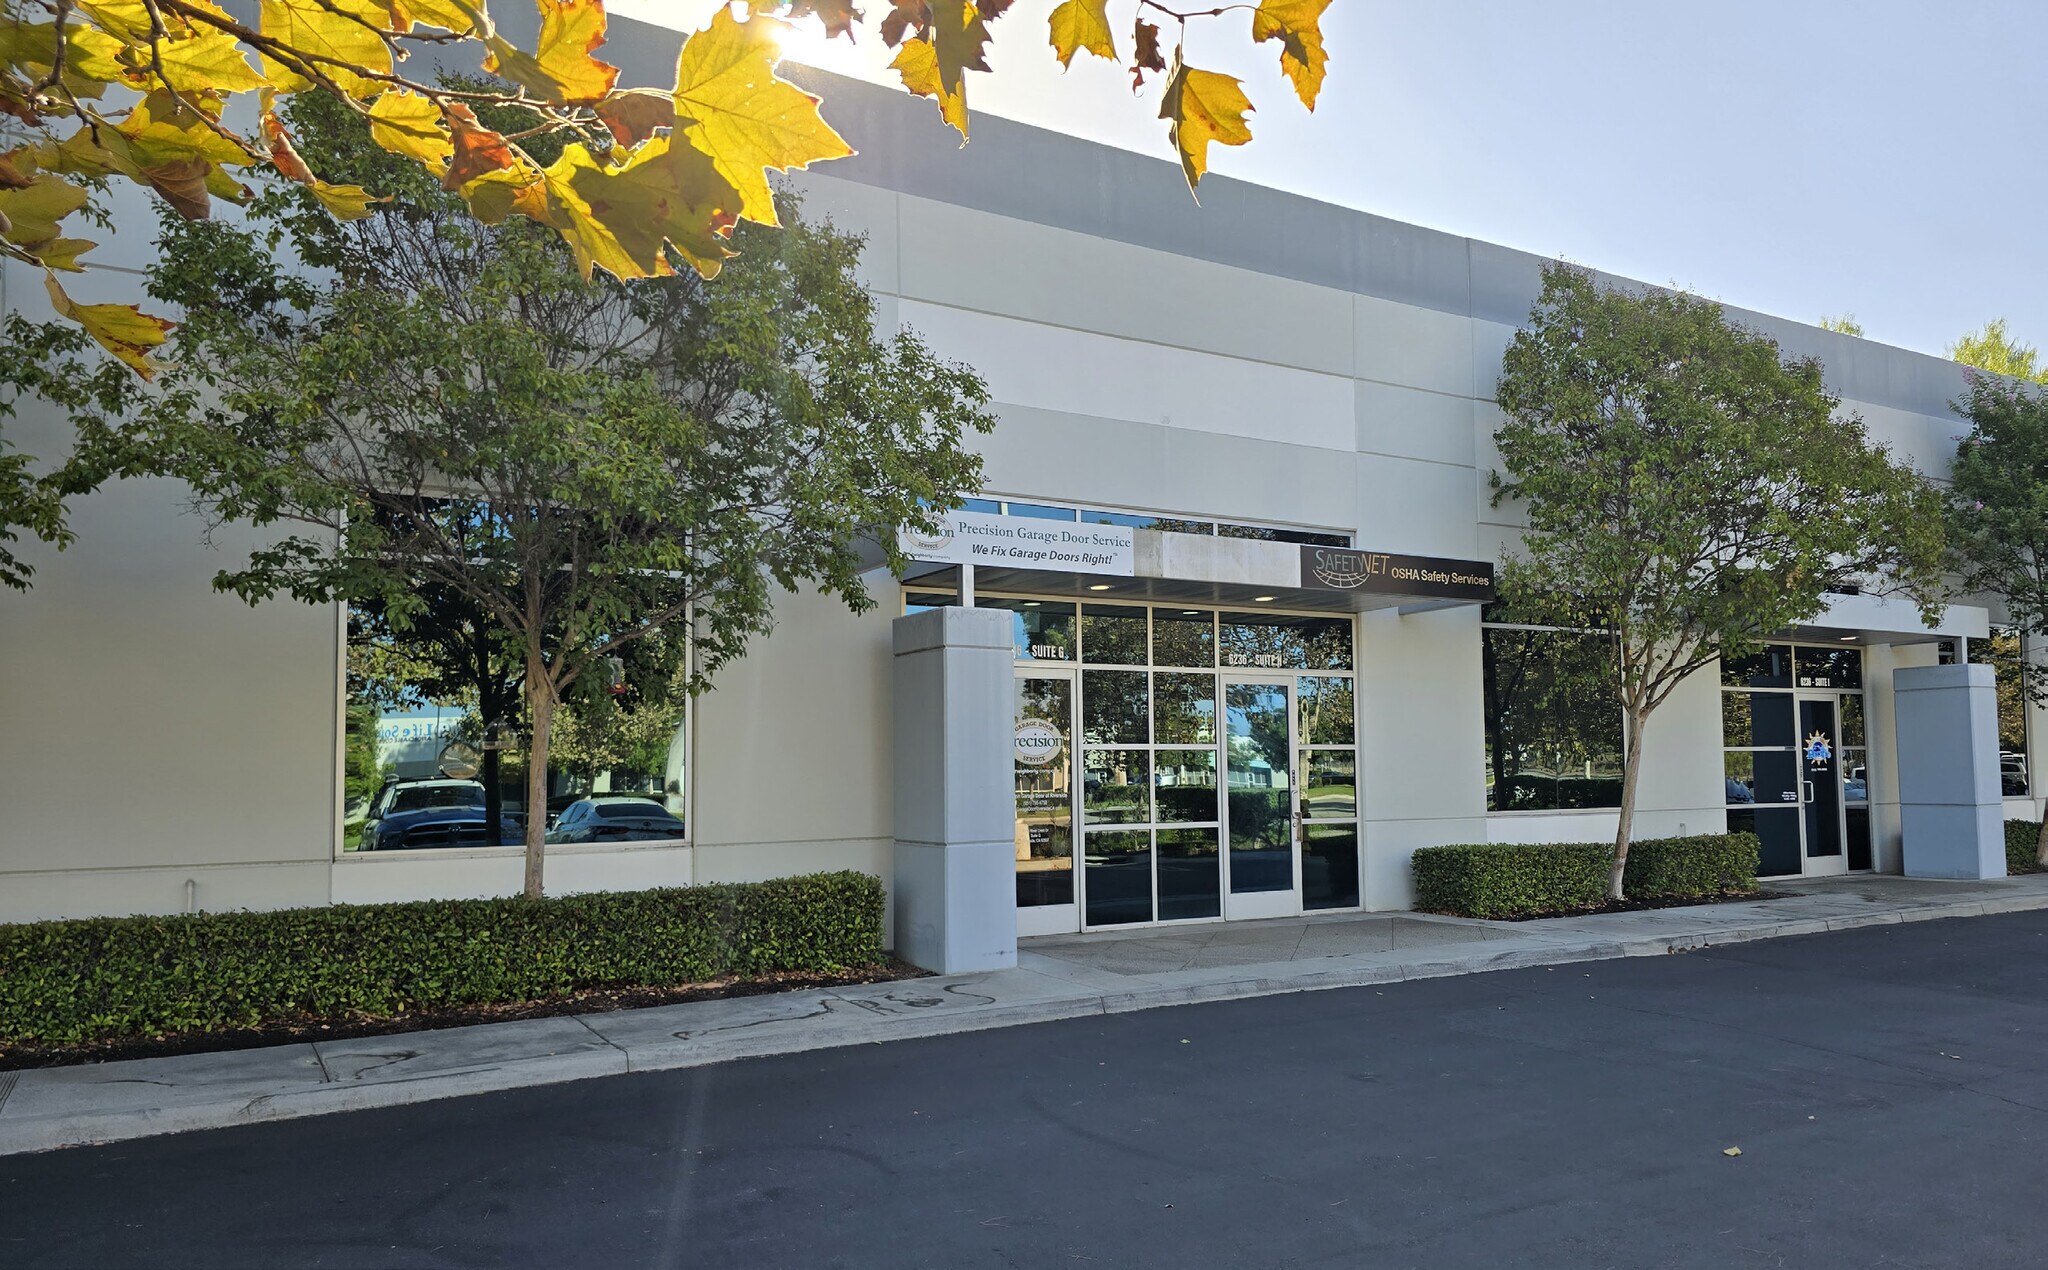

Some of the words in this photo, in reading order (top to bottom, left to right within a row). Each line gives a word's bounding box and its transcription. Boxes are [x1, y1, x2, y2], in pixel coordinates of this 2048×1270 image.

[958, 521, 1014, 538] Precision
[1017, 527, 1058, 544] Garage
[1061, 531, 1090, 544] Door
[1092, 533, 1131, 548] Service
[972, 543, 988, 555] We
[991, 545, 1007, 557] Fix
[1009, 547, 1047, 562] Garage
[1049, 550, 1080, 563] Doors
[1081, 553, 1113, 566] Right!
[1391, 567, 1420, 581] OSHA
[1421, 569, 1450, 585] Safety
[1451, 572, 1490, 586] Services
[1031, 644, 1057, 658] SUITE
[1058, 646, 1065, 659] G
[1228, 653, 1247, 665] 6236
[1255, 654, 1276, 667] SUITE
[1815, 677, 1828, 687] SUITE
[1014, 721, 1037, 732] GARAGE
[1038, 721, 1054, 731] DOOR
[1014, 732, 1064, 748] recision
[1022, 755, 1046, 763] SERVICE
